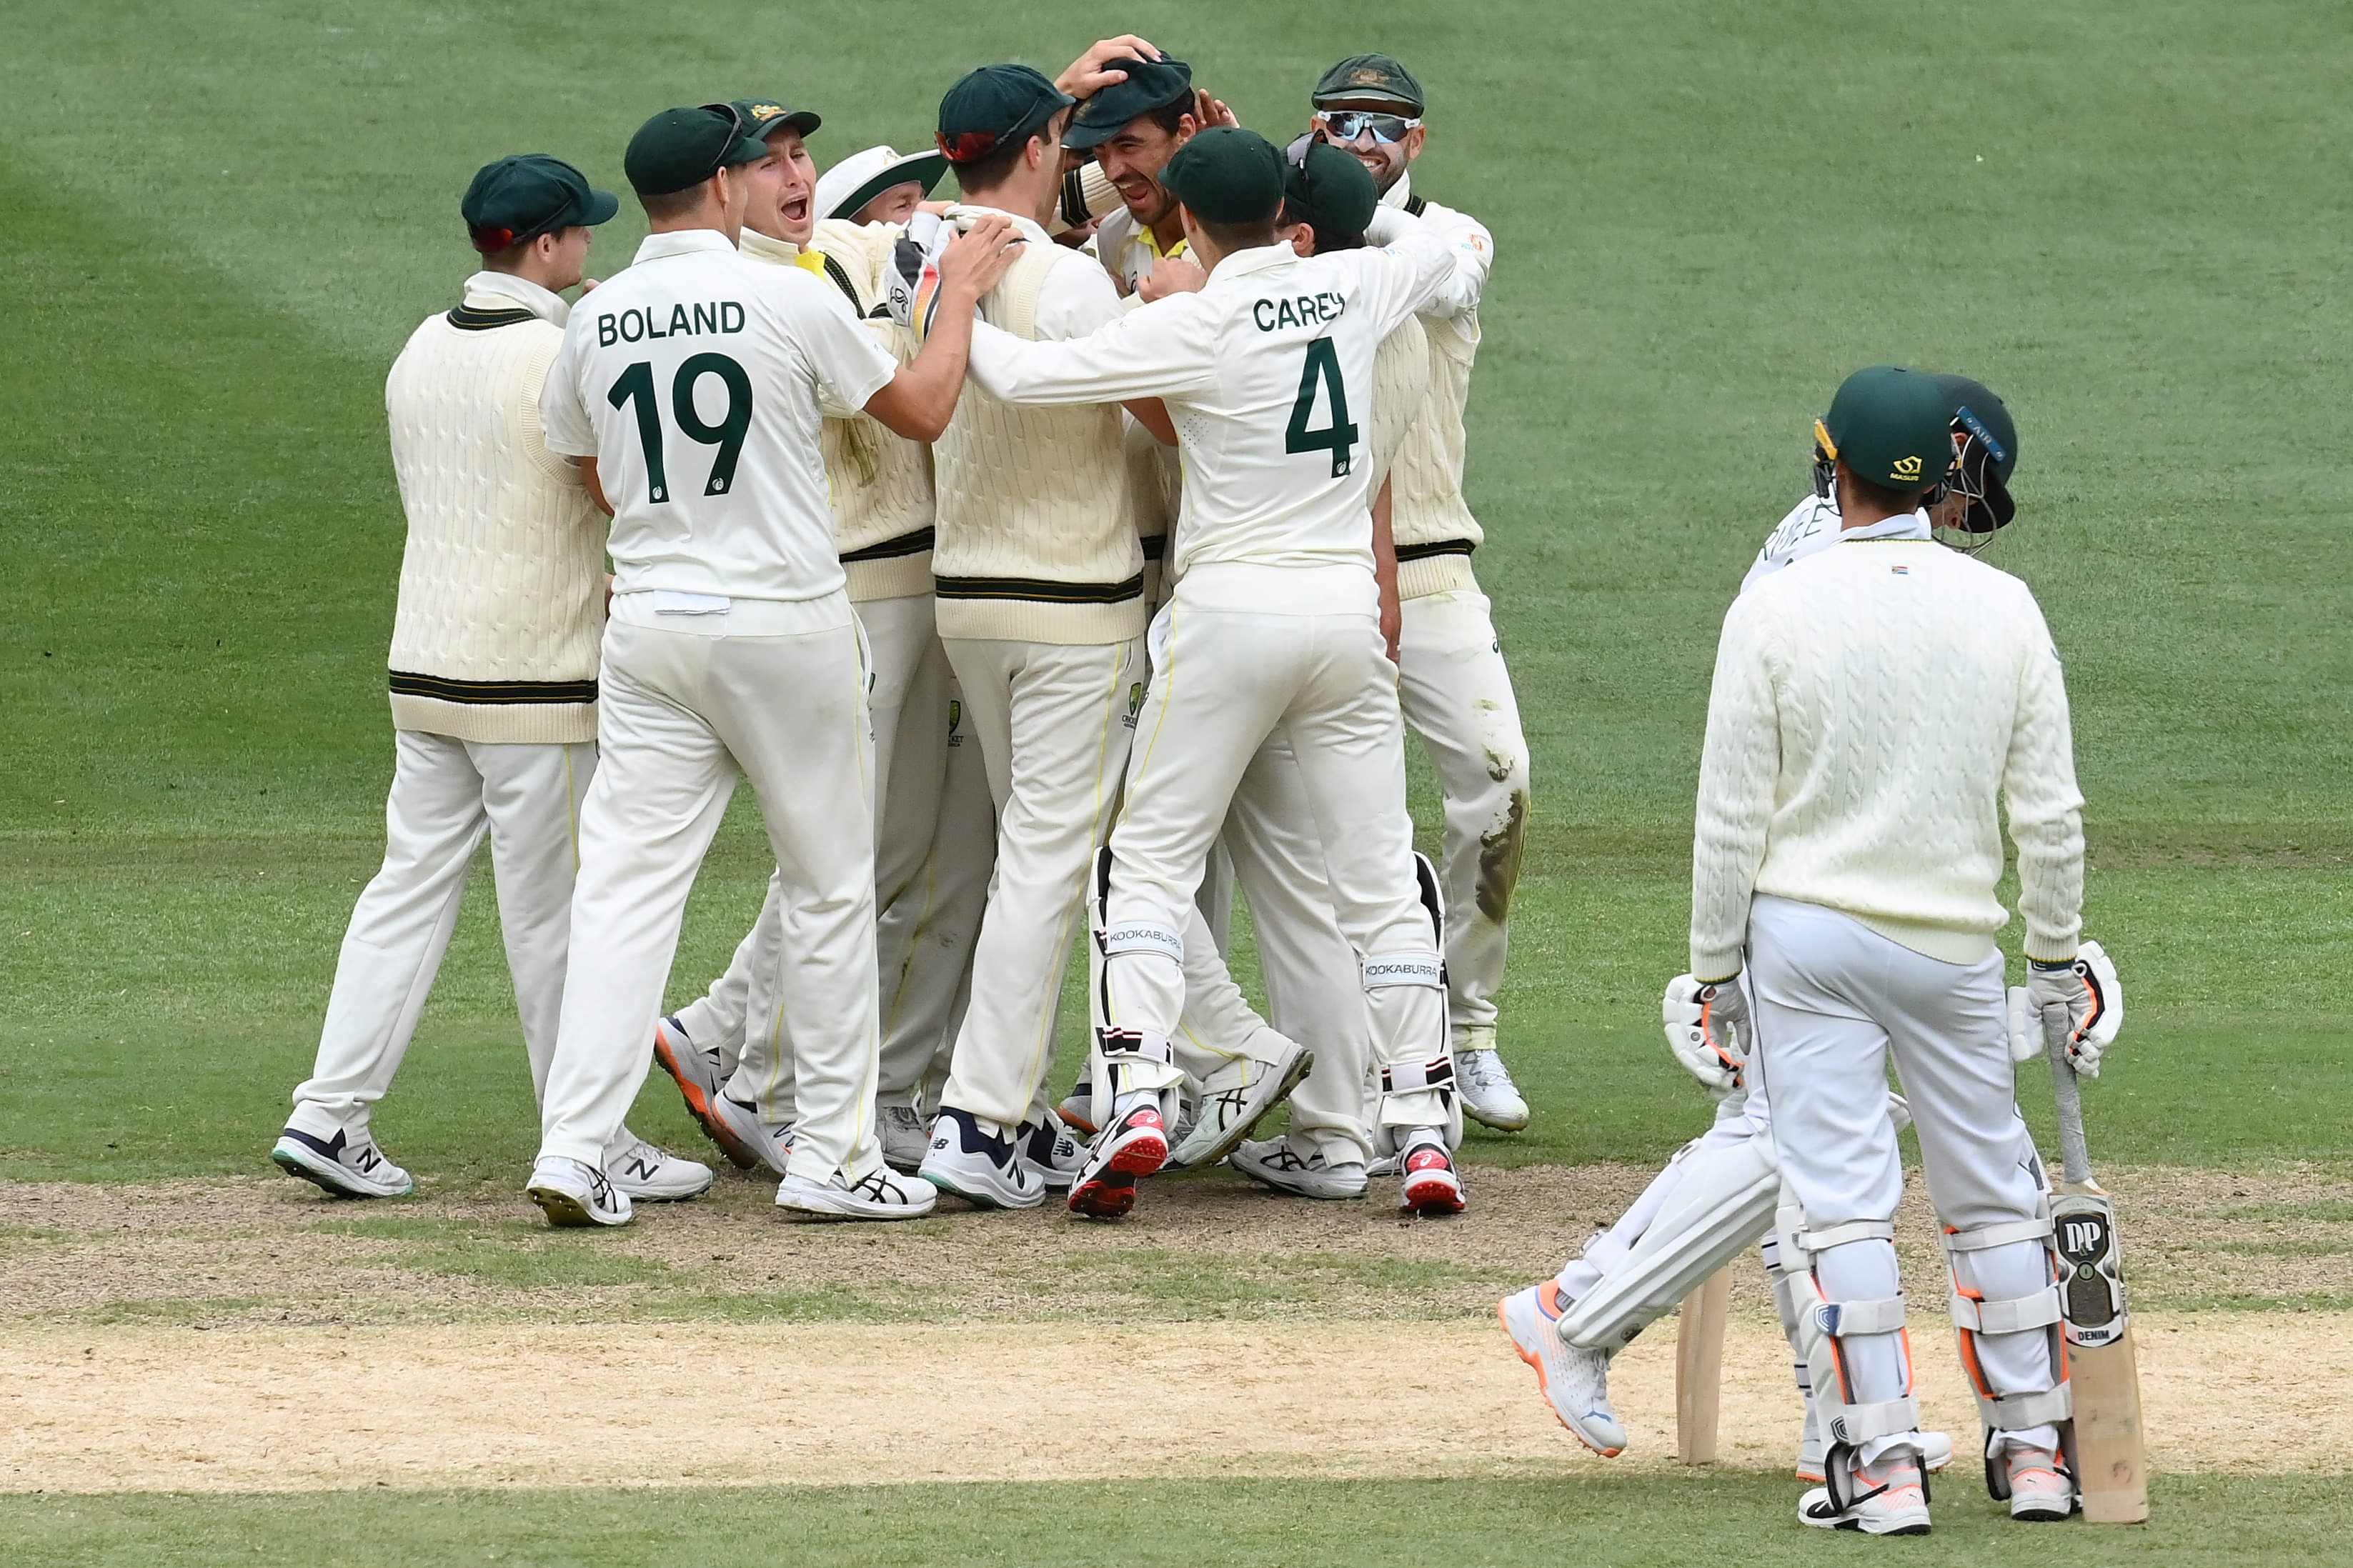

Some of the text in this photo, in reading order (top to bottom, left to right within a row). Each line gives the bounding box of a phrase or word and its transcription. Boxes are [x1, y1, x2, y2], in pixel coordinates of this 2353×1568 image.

[597, 301, 745, 348] BOLAND
[1253, 292, 1345, 332] CAREY
[1285, 336, 1358, 478] 4
[607, 351, 753, 504] 19
[1110, 929, 1182, 950] KOOKABURRA
[1365, 964, 1438, 977] KOOKABURRA
[2077, 1330, 2110, 1341] DENIM
